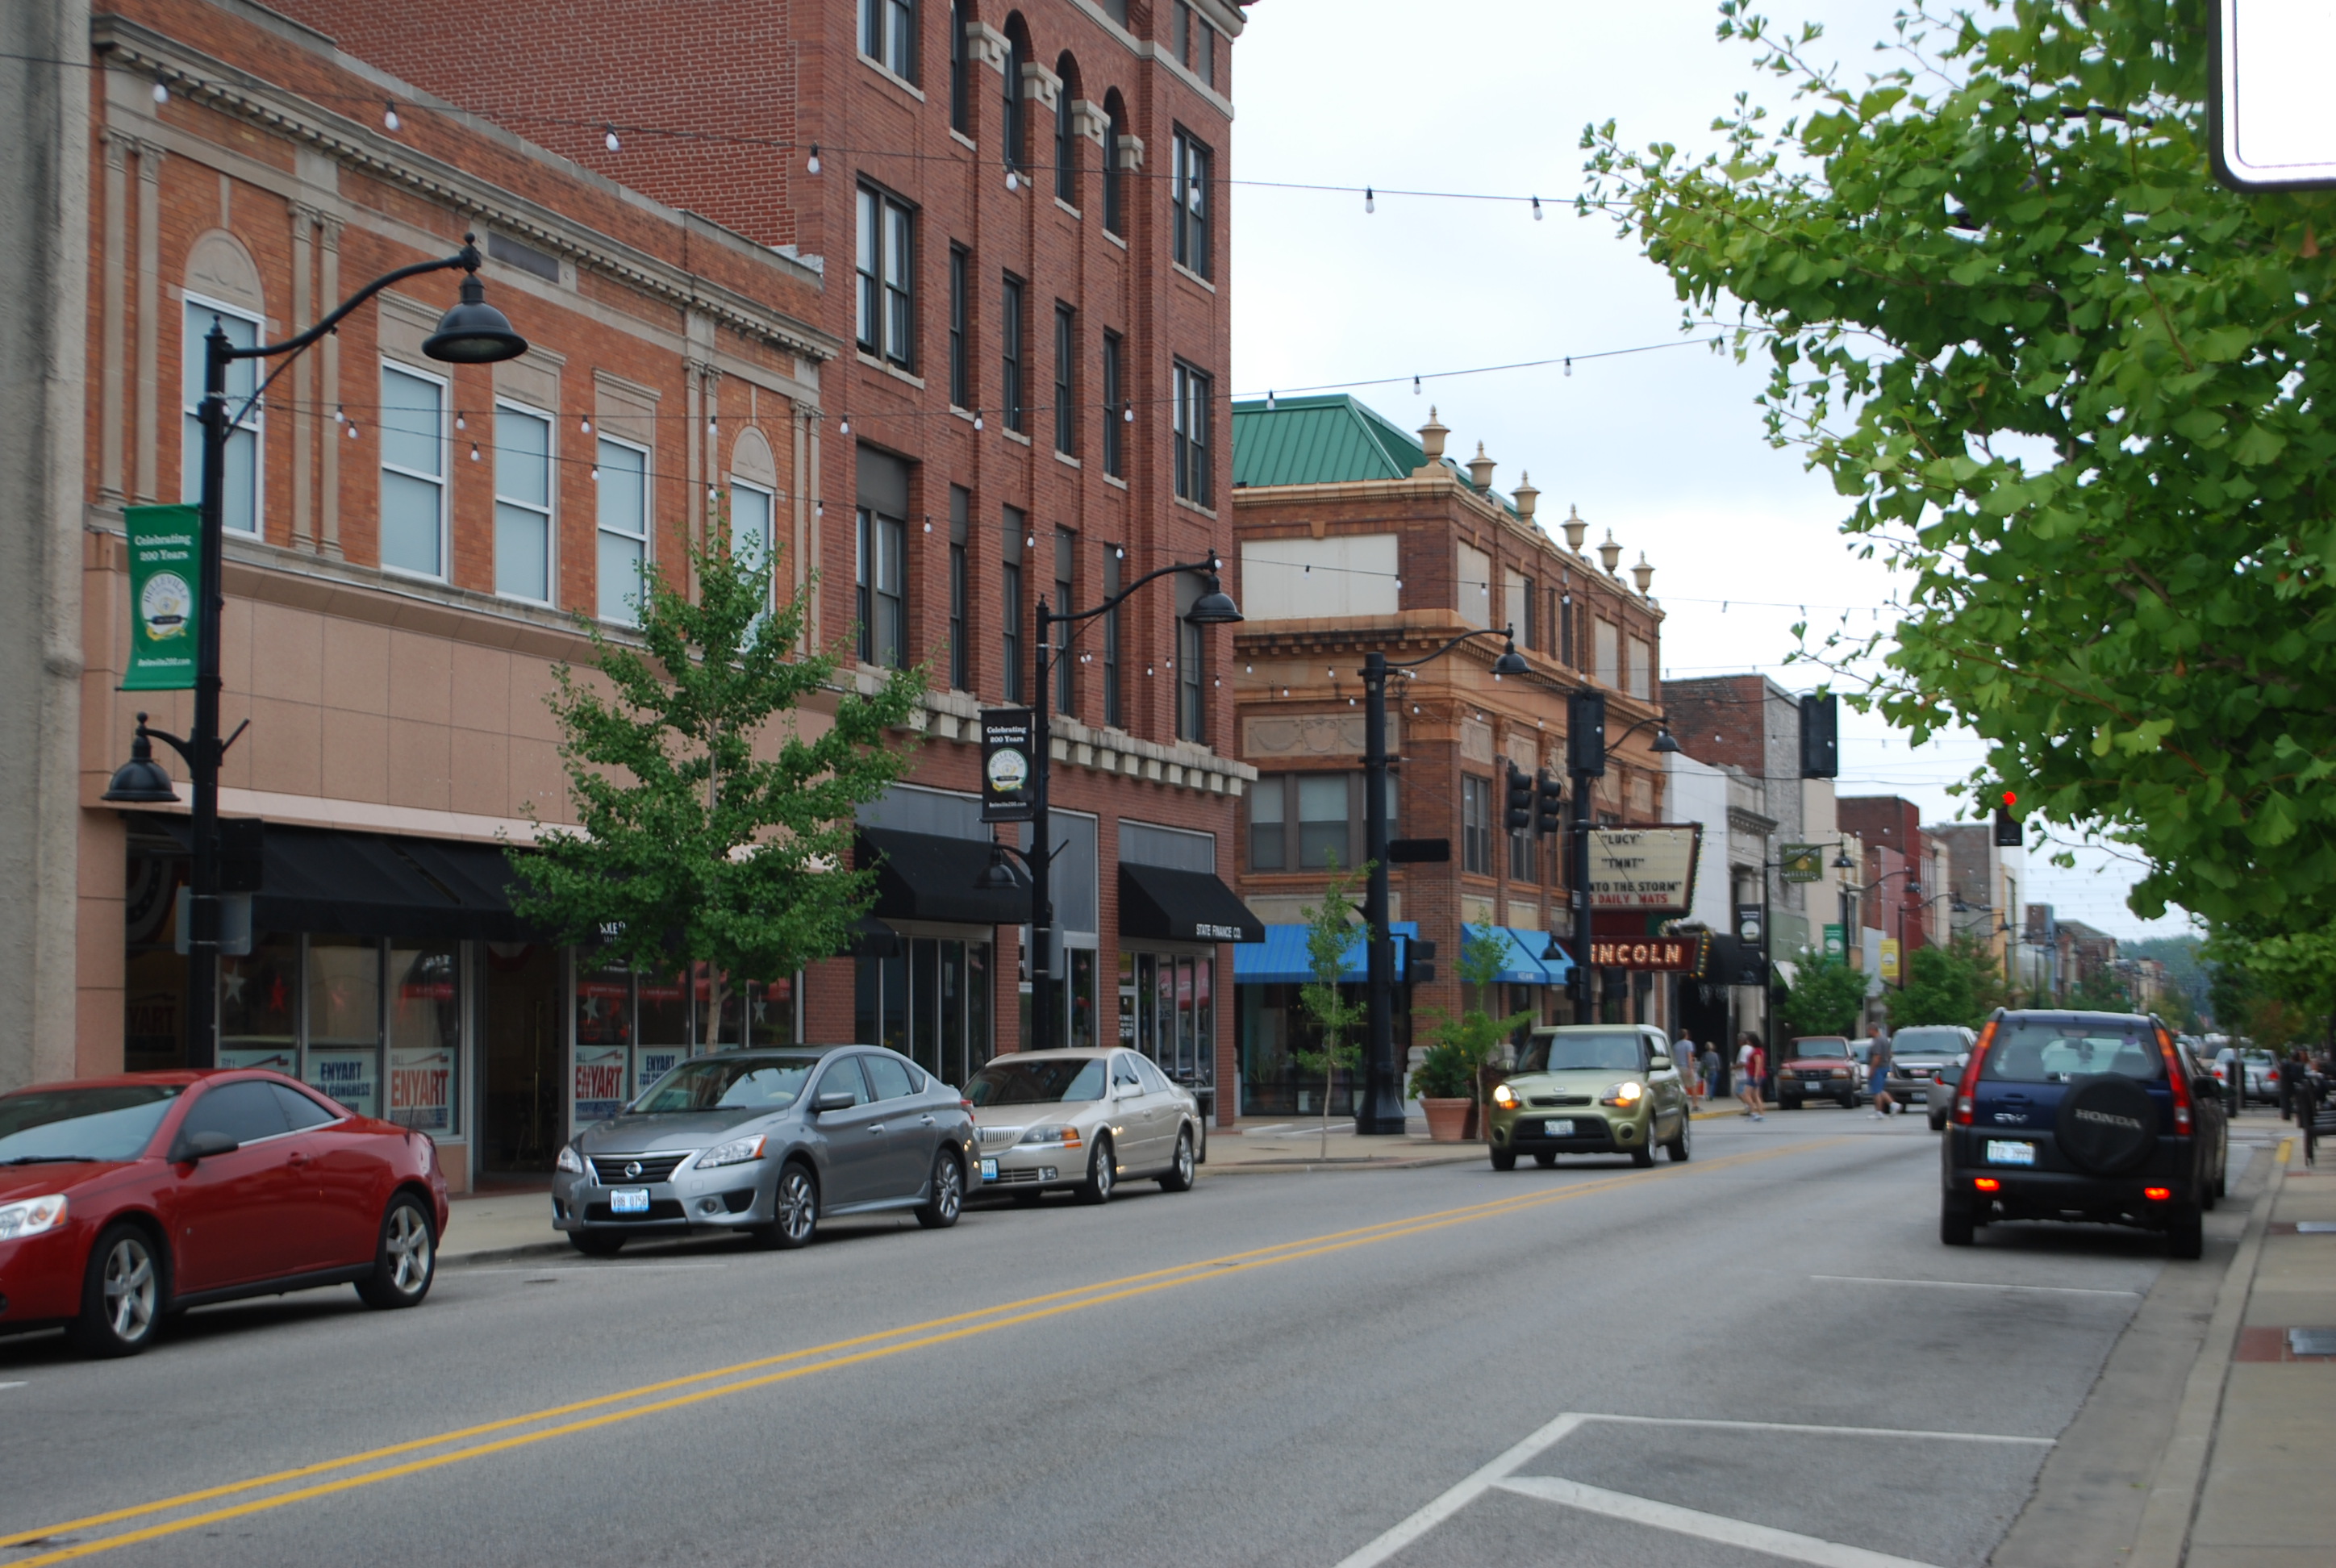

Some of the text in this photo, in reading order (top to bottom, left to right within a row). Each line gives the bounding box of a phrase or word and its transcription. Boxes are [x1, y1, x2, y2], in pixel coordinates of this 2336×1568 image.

[134, 533, 192, 546] Celebrating
[140, 549, 189, 561] 200 Years
[144, 575, 187, 604] BELLEVILLE
[137, 657, 191, 667] Belleville200.com
[987, 725, 1026, 734] Celebrating
[1004, 735, 1024, 743] Years
[991, 750, 1024, 768] BELLEVILLE
[1601, 857, 1645, 868] "TMNT"
[1589, 881, 1682, 892] NTO THE STORM"
[1598, 894, 1630, 904] DAILY
[1639, 893, 1668, 904] MATS
[1196, 923, 1241, 939] STATE FINANCE CO.
[1590, 943, 1683, 965] INCOLN
[127, 1006, 176, 1033] YART
[646, 1055, 675, 1071] ENYART
[320, 1061, 363, 1081] ENYART
[575, 1065, 623, 1099] ENYART
[640, 1073, 650, 1085] FOR
[328, 1082, 370, 1097] CONGRESS
[391, 1069, 448, 1107] ENYART
[2075, 1108, 2142, 1130] HONDA
